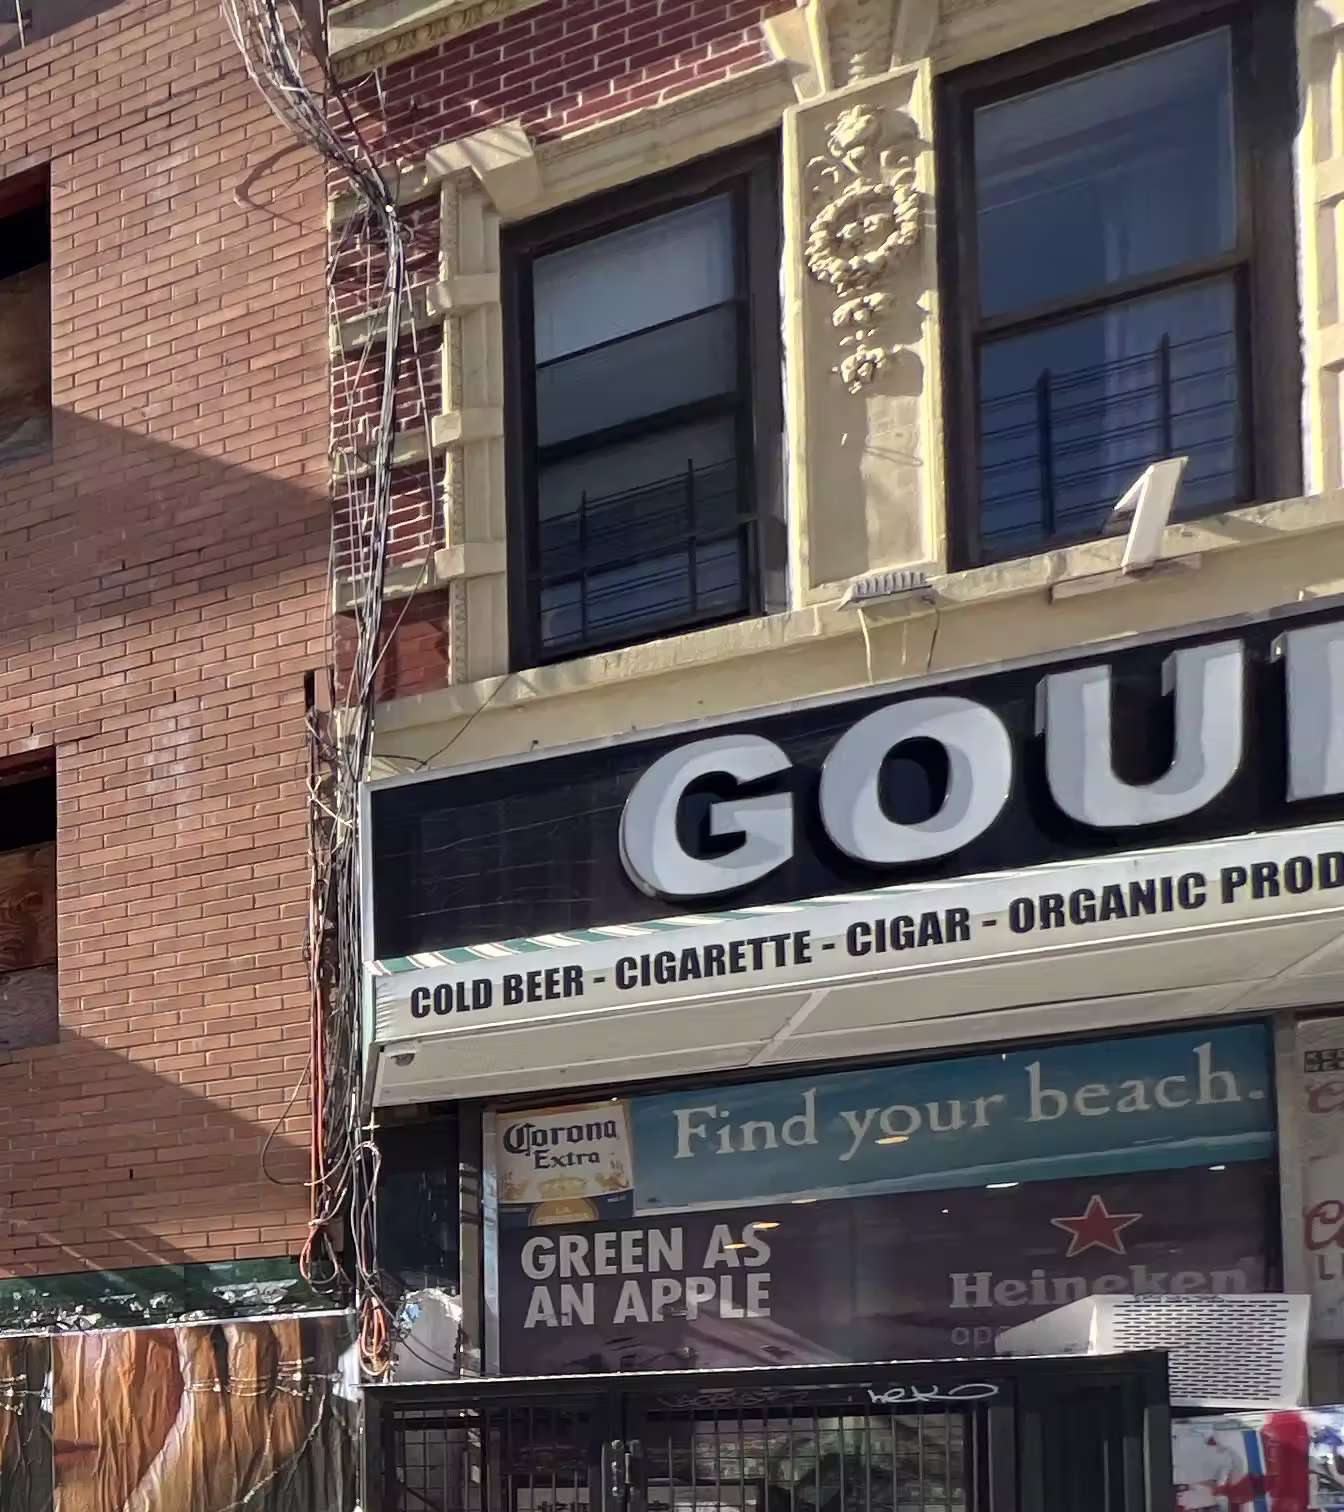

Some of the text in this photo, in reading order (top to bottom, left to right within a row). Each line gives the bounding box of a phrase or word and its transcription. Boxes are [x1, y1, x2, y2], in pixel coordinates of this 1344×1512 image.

[410, 977, 492, 1018] COLD
[502, 964, 584, 1006] BEER
[615, 930, 812, 990] CIGARETTE
[846, 907, 971, 957] CIGAR
[1008, 871, 1207, 934] ORGANIC
[1220, 851, 1344, 904] PROD
[673, 1088, 819, 1160] Find
[839, 1092, 1008, 1161] your
[1024, 1043, 1266, 1124] beach.
[503, 1118, 618, 1157] Corona
[533, 1149, 601, 1170] Extra
[521, 1222, 772, 1280] GREEN AS
[524, 1273, 772, 1329] AN APPLE
[948, 1264, 1249, 1309] Heineken
